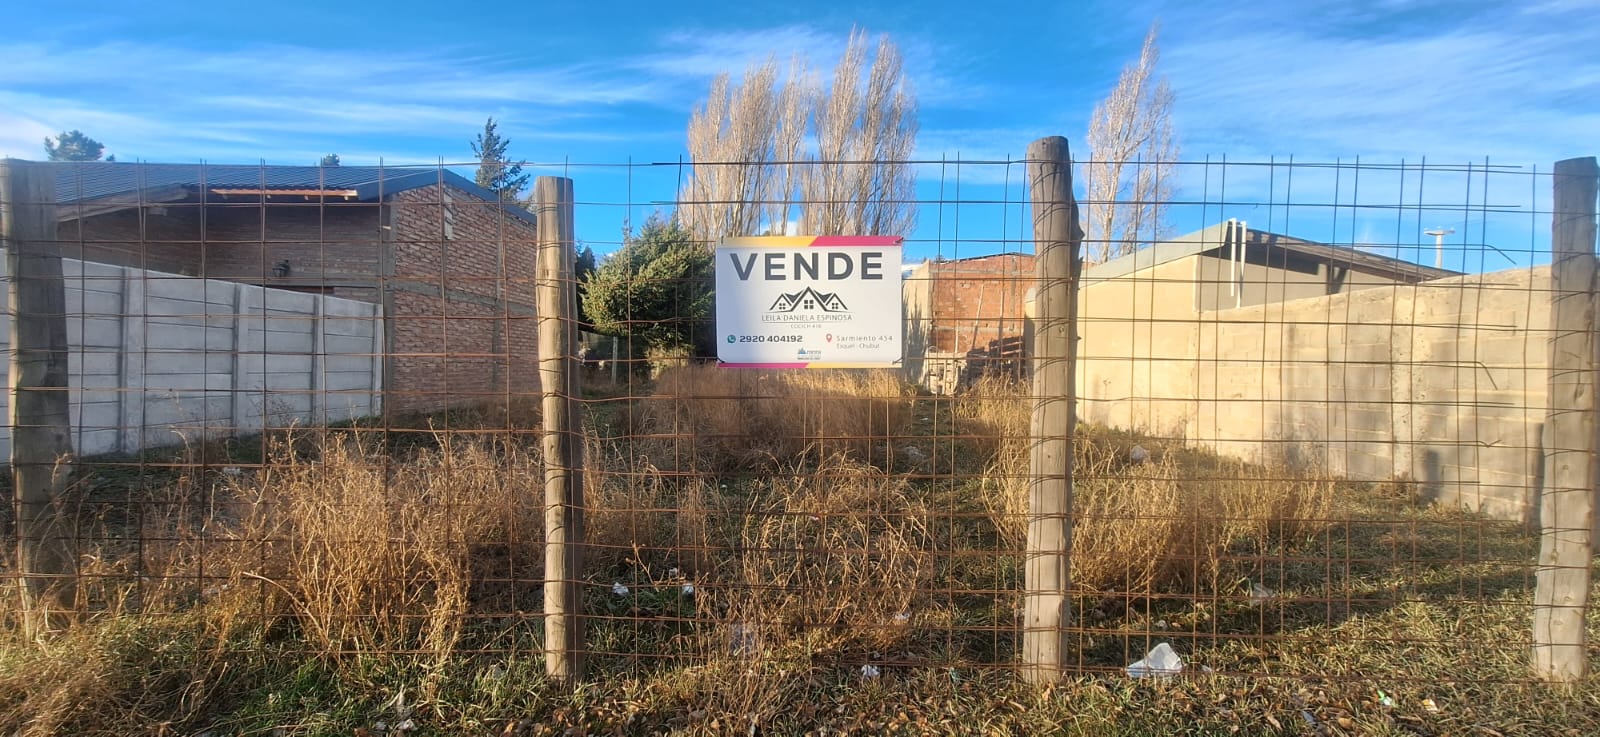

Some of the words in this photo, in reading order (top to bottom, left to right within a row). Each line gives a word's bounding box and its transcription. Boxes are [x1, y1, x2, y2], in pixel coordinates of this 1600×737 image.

[730, 252, 883, 280] VENDE
[739, 335, 765, 343] 2920
[767, 335, 803, 343] 404192
